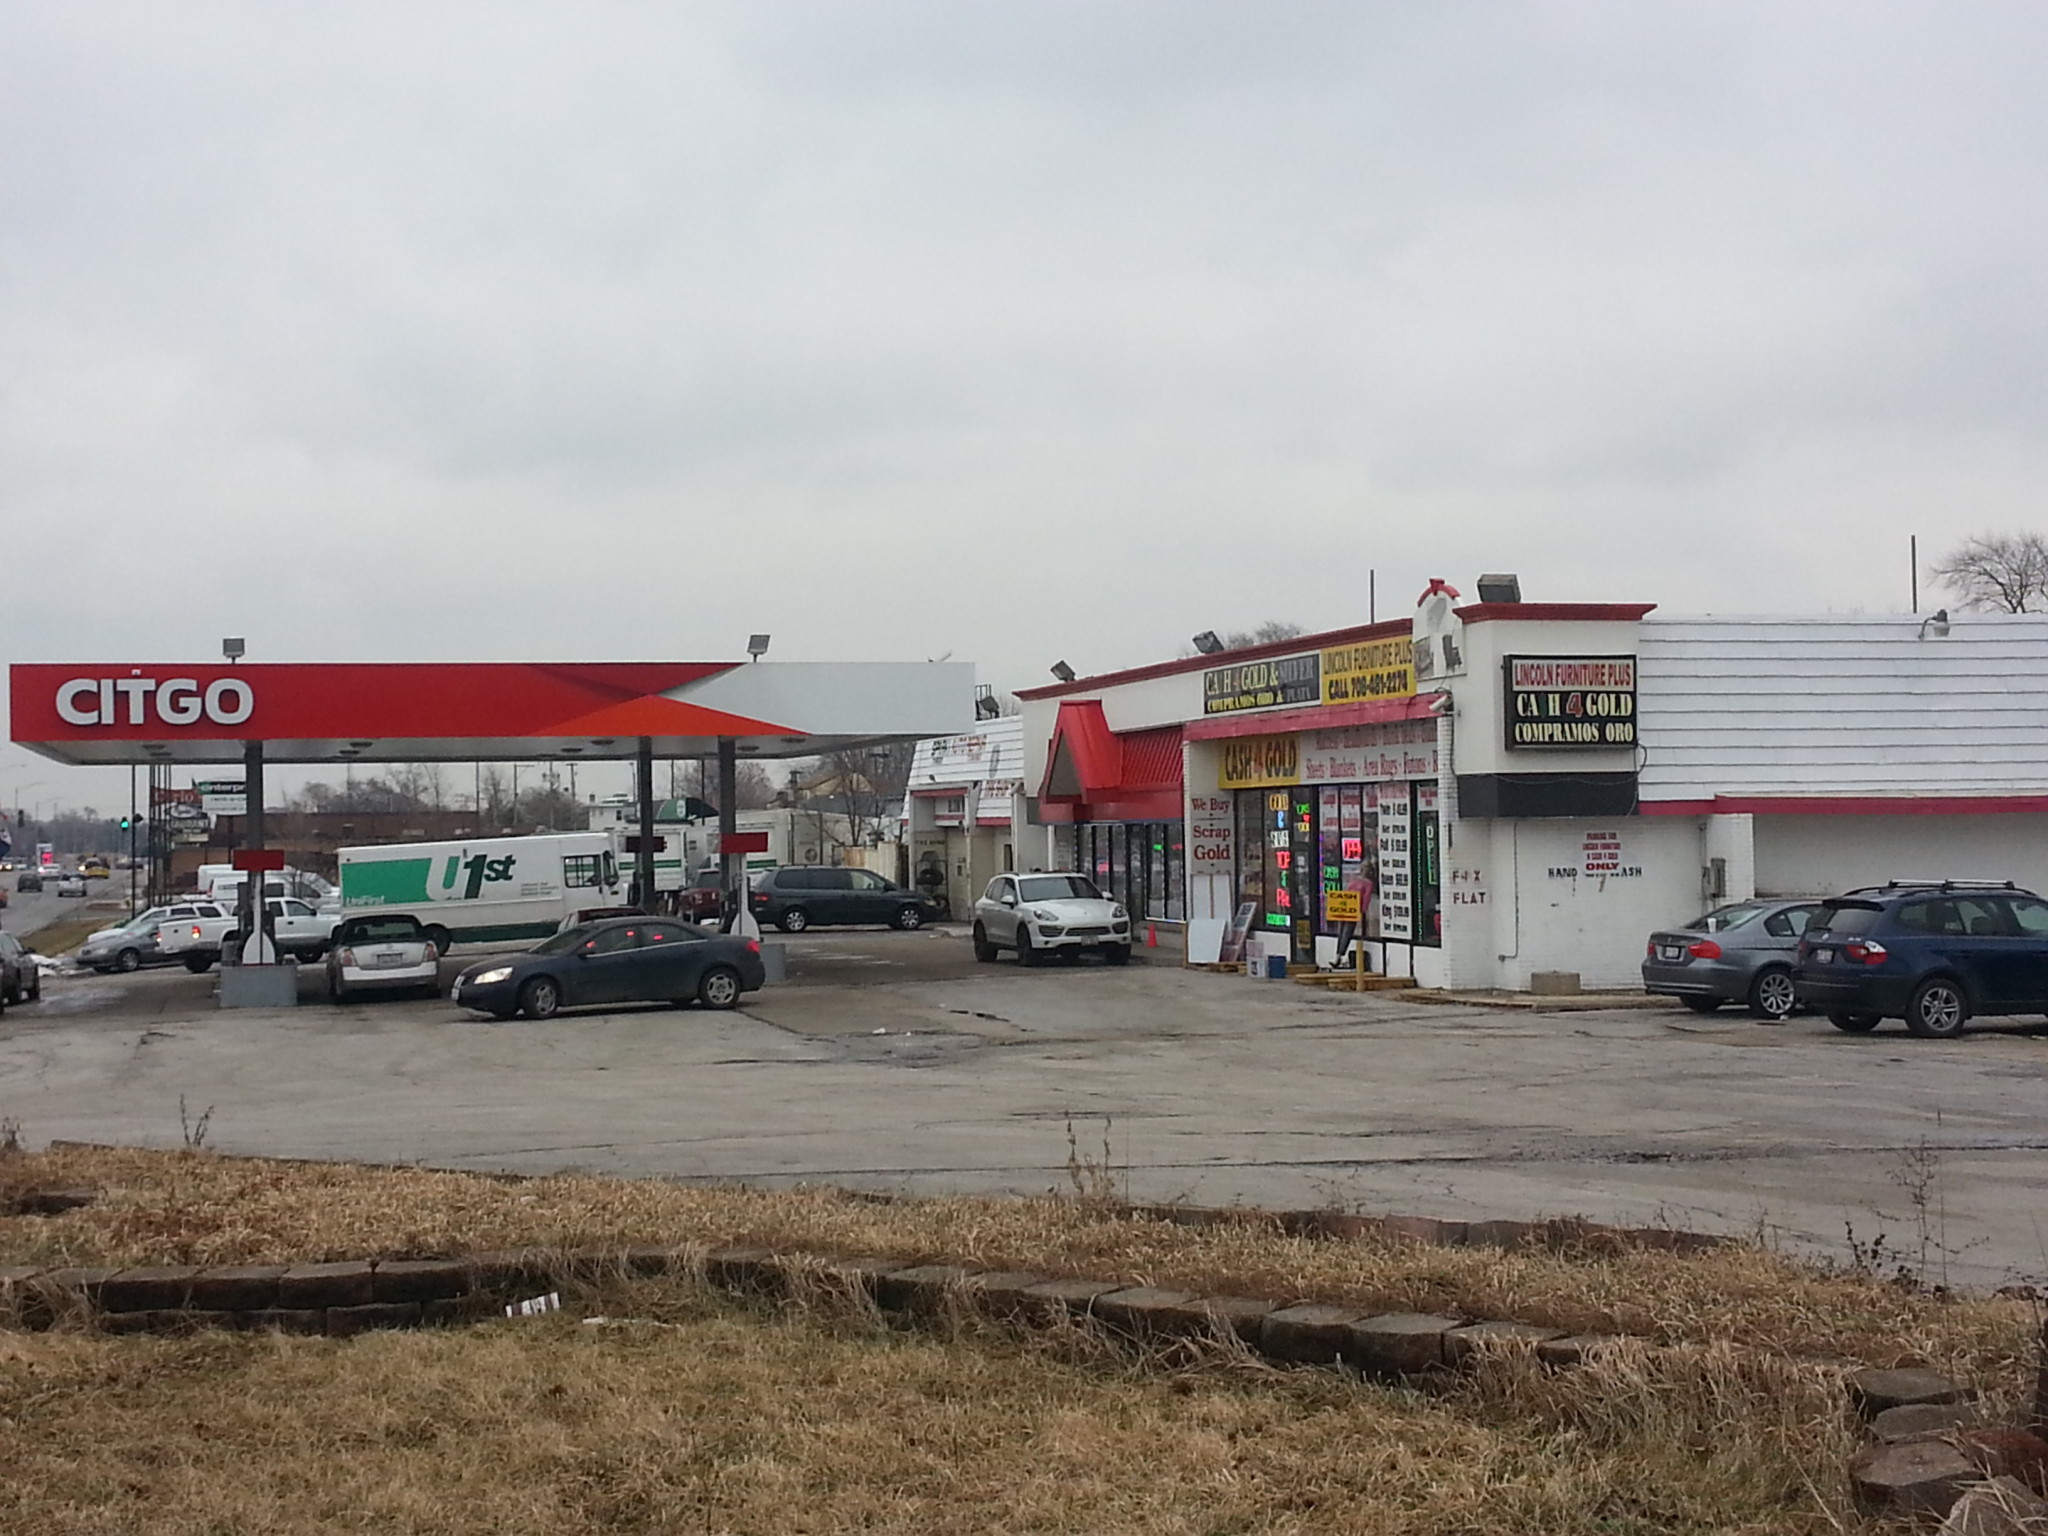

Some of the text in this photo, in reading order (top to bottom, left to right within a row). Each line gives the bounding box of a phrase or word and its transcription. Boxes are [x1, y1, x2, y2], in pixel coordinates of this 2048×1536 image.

[1241, 664, 1267, 690] GOLD
[1515, 663, 1631, 686] LINCOLN FURNITURE PLUS
[1329, 678, 1349, 700] CALL
[55, 678, 254, 726] CITGO
[1566, 692, 1583, 718] 4
[1585, 692, 1633, 717] GOLD
[1515, 722, 1634, 742] COMPRAMOS ORO
[1225, 740, 1297, 782] CASH 4 GOLD
[1192, 798, 1231, 813] We Buy
[1193, 825, 1231, 841] Scrap
[1194, 844, 1231, 861] Gold
[1548, 868, 1578, 878] HAND
[1585, 862, 1619, 871] ONLY
[1329, 892, 1357, 900] CASH
[1453, 892, 1486, 904] FLAT
